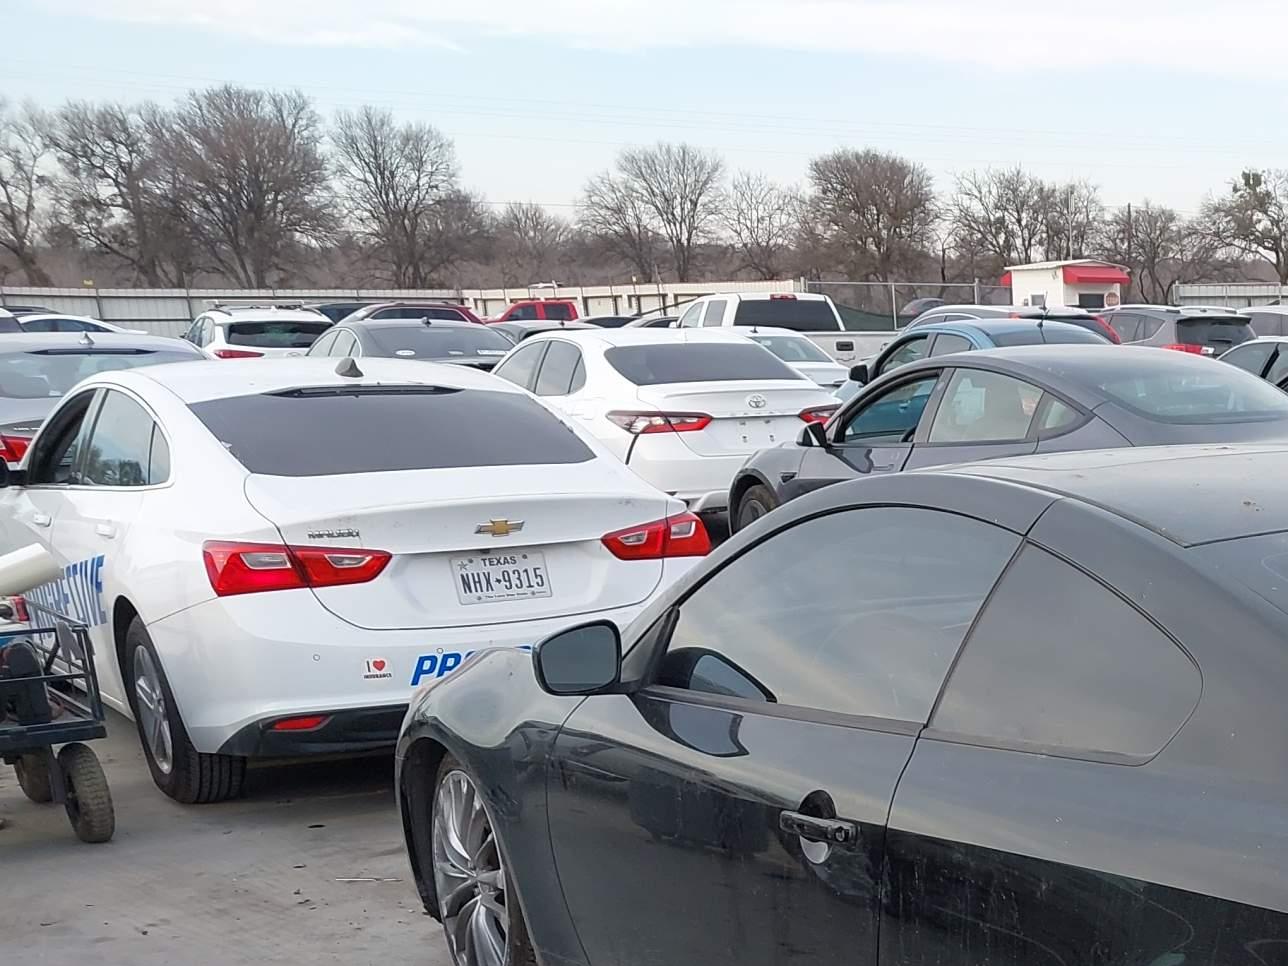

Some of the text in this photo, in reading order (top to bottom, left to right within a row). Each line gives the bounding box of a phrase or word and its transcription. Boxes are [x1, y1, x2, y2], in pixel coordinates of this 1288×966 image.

[481, 556, 517, 567] TEXAS
[460, 567, 545, 594] NHX 9315
